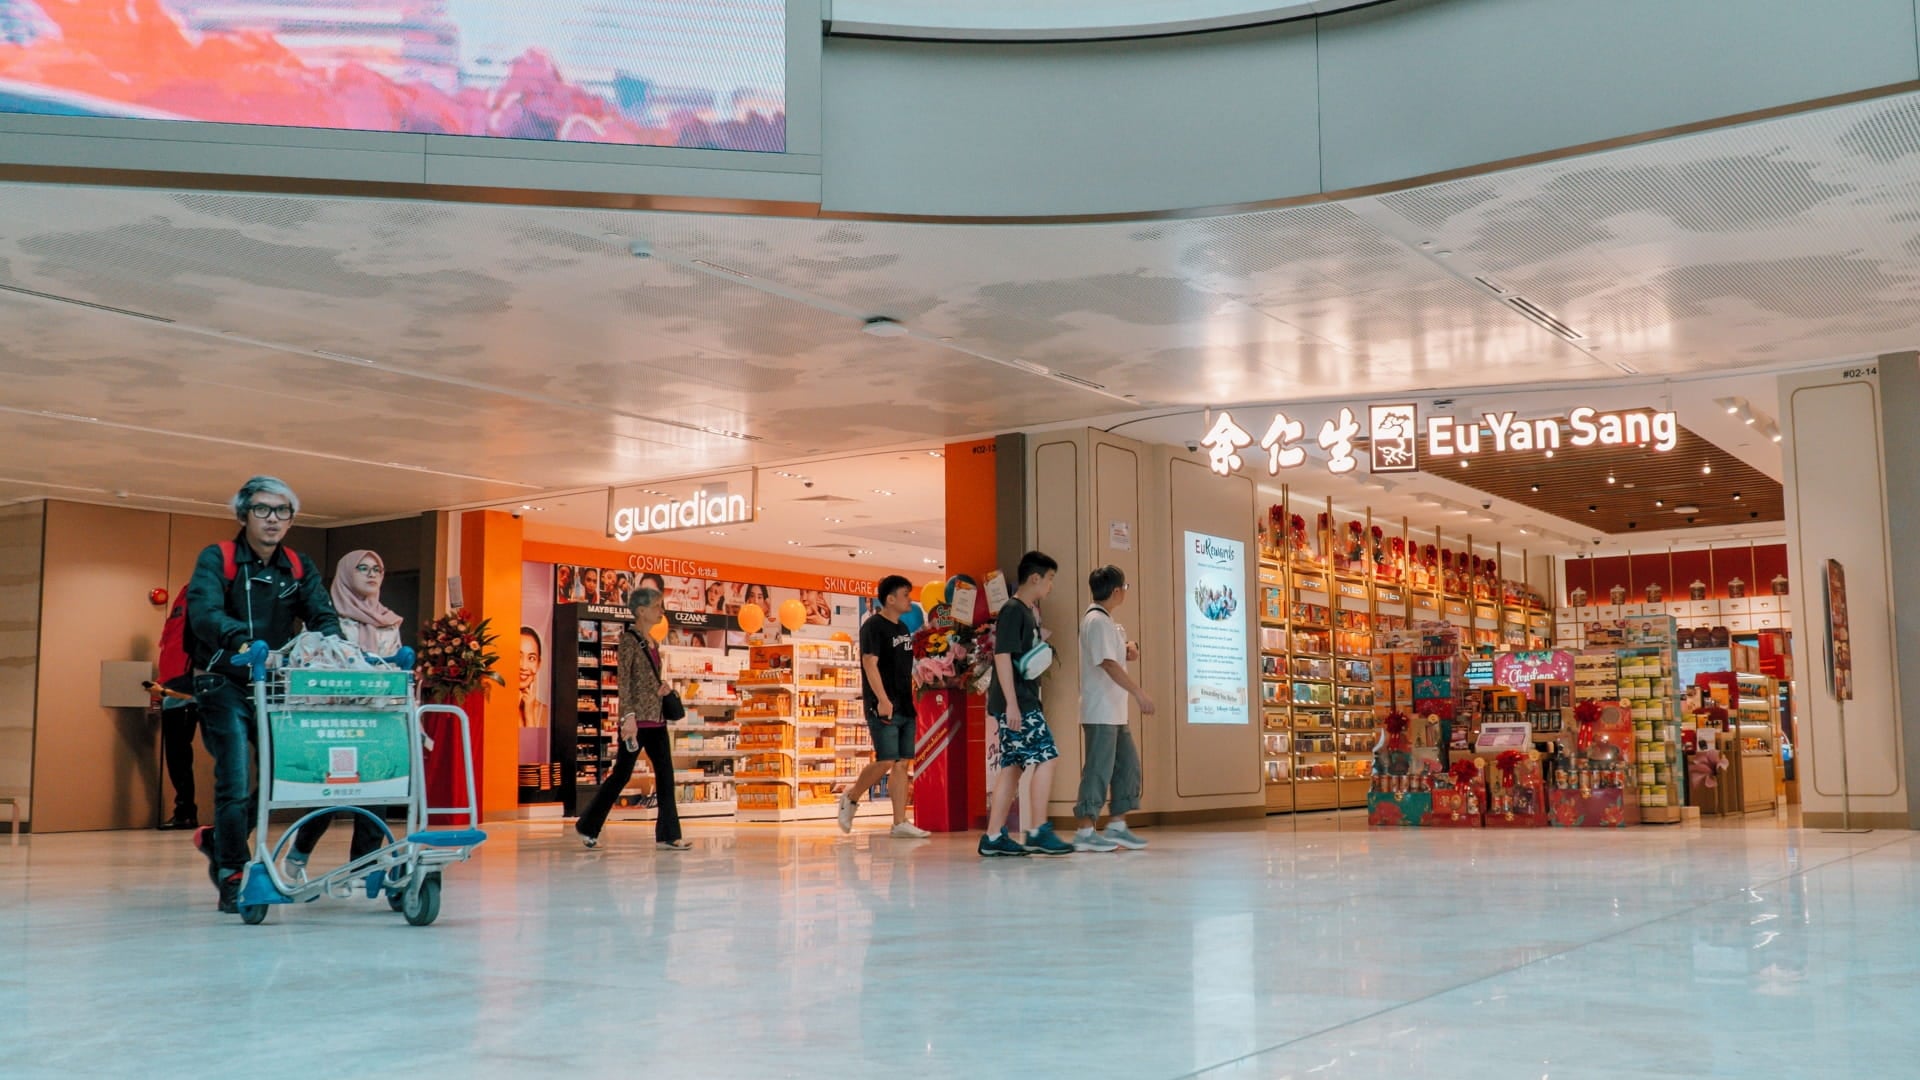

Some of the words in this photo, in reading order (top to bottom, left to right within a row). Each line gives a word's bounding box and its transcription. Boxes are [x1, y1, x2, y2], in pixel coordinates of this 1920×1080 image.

[1843, 367, 1877, 378] #02-14
[1429, 418, 1480, 455] Eu
[1485, 412, 1559, 451] Yan
[1569, 407, 1677, 453] Sang
[1201, 408, 1361, 474] 余仁生
[614, 490, 745, 542] guardian
[628, 555, 696, 576] COSMETICS
[824, 577, 847, 592] SKIN
[849, 579, 872, 594] CARE
[587, 605, 632, 615] MAYBELLIN
[675, 612, 709, 623] CEZANNE
